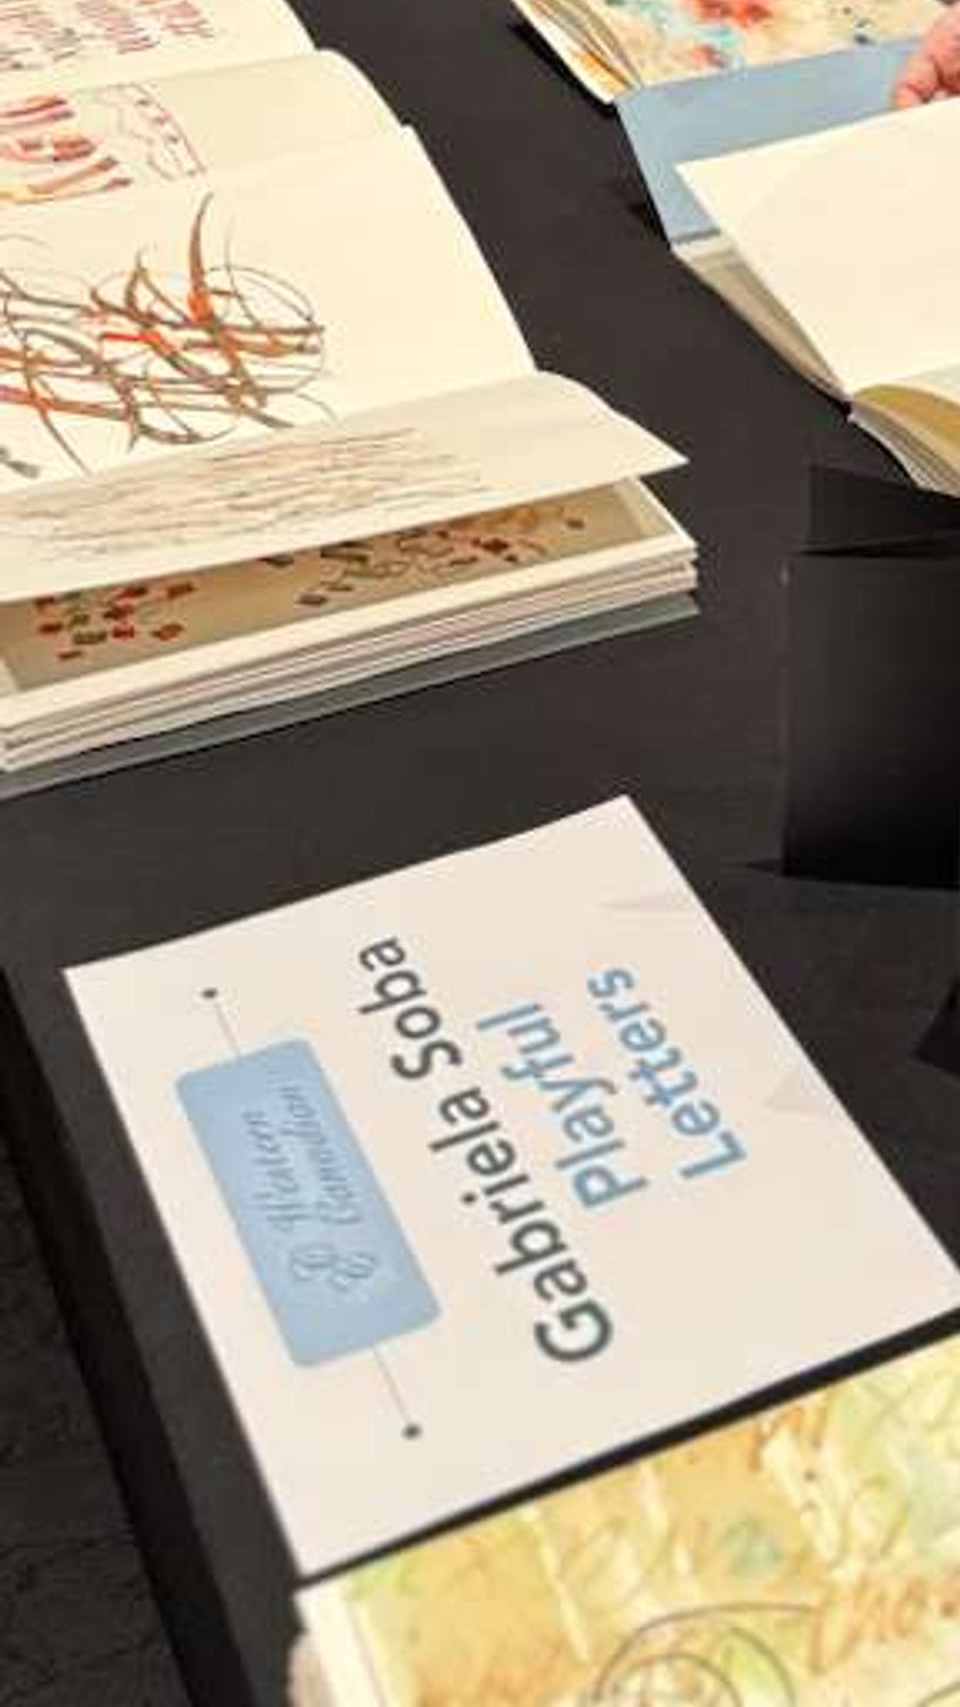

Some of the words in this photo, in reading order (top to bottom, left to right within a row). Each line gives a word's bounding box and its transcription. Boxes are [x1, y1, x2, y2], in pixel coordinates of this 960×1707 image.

[358, 937, 463, 1081] Soba
[476, 1003, 649, 1209] Playful
[587, 969, 747, 1179] Letters
[429, 1086, 614, 1363] Gabriela
